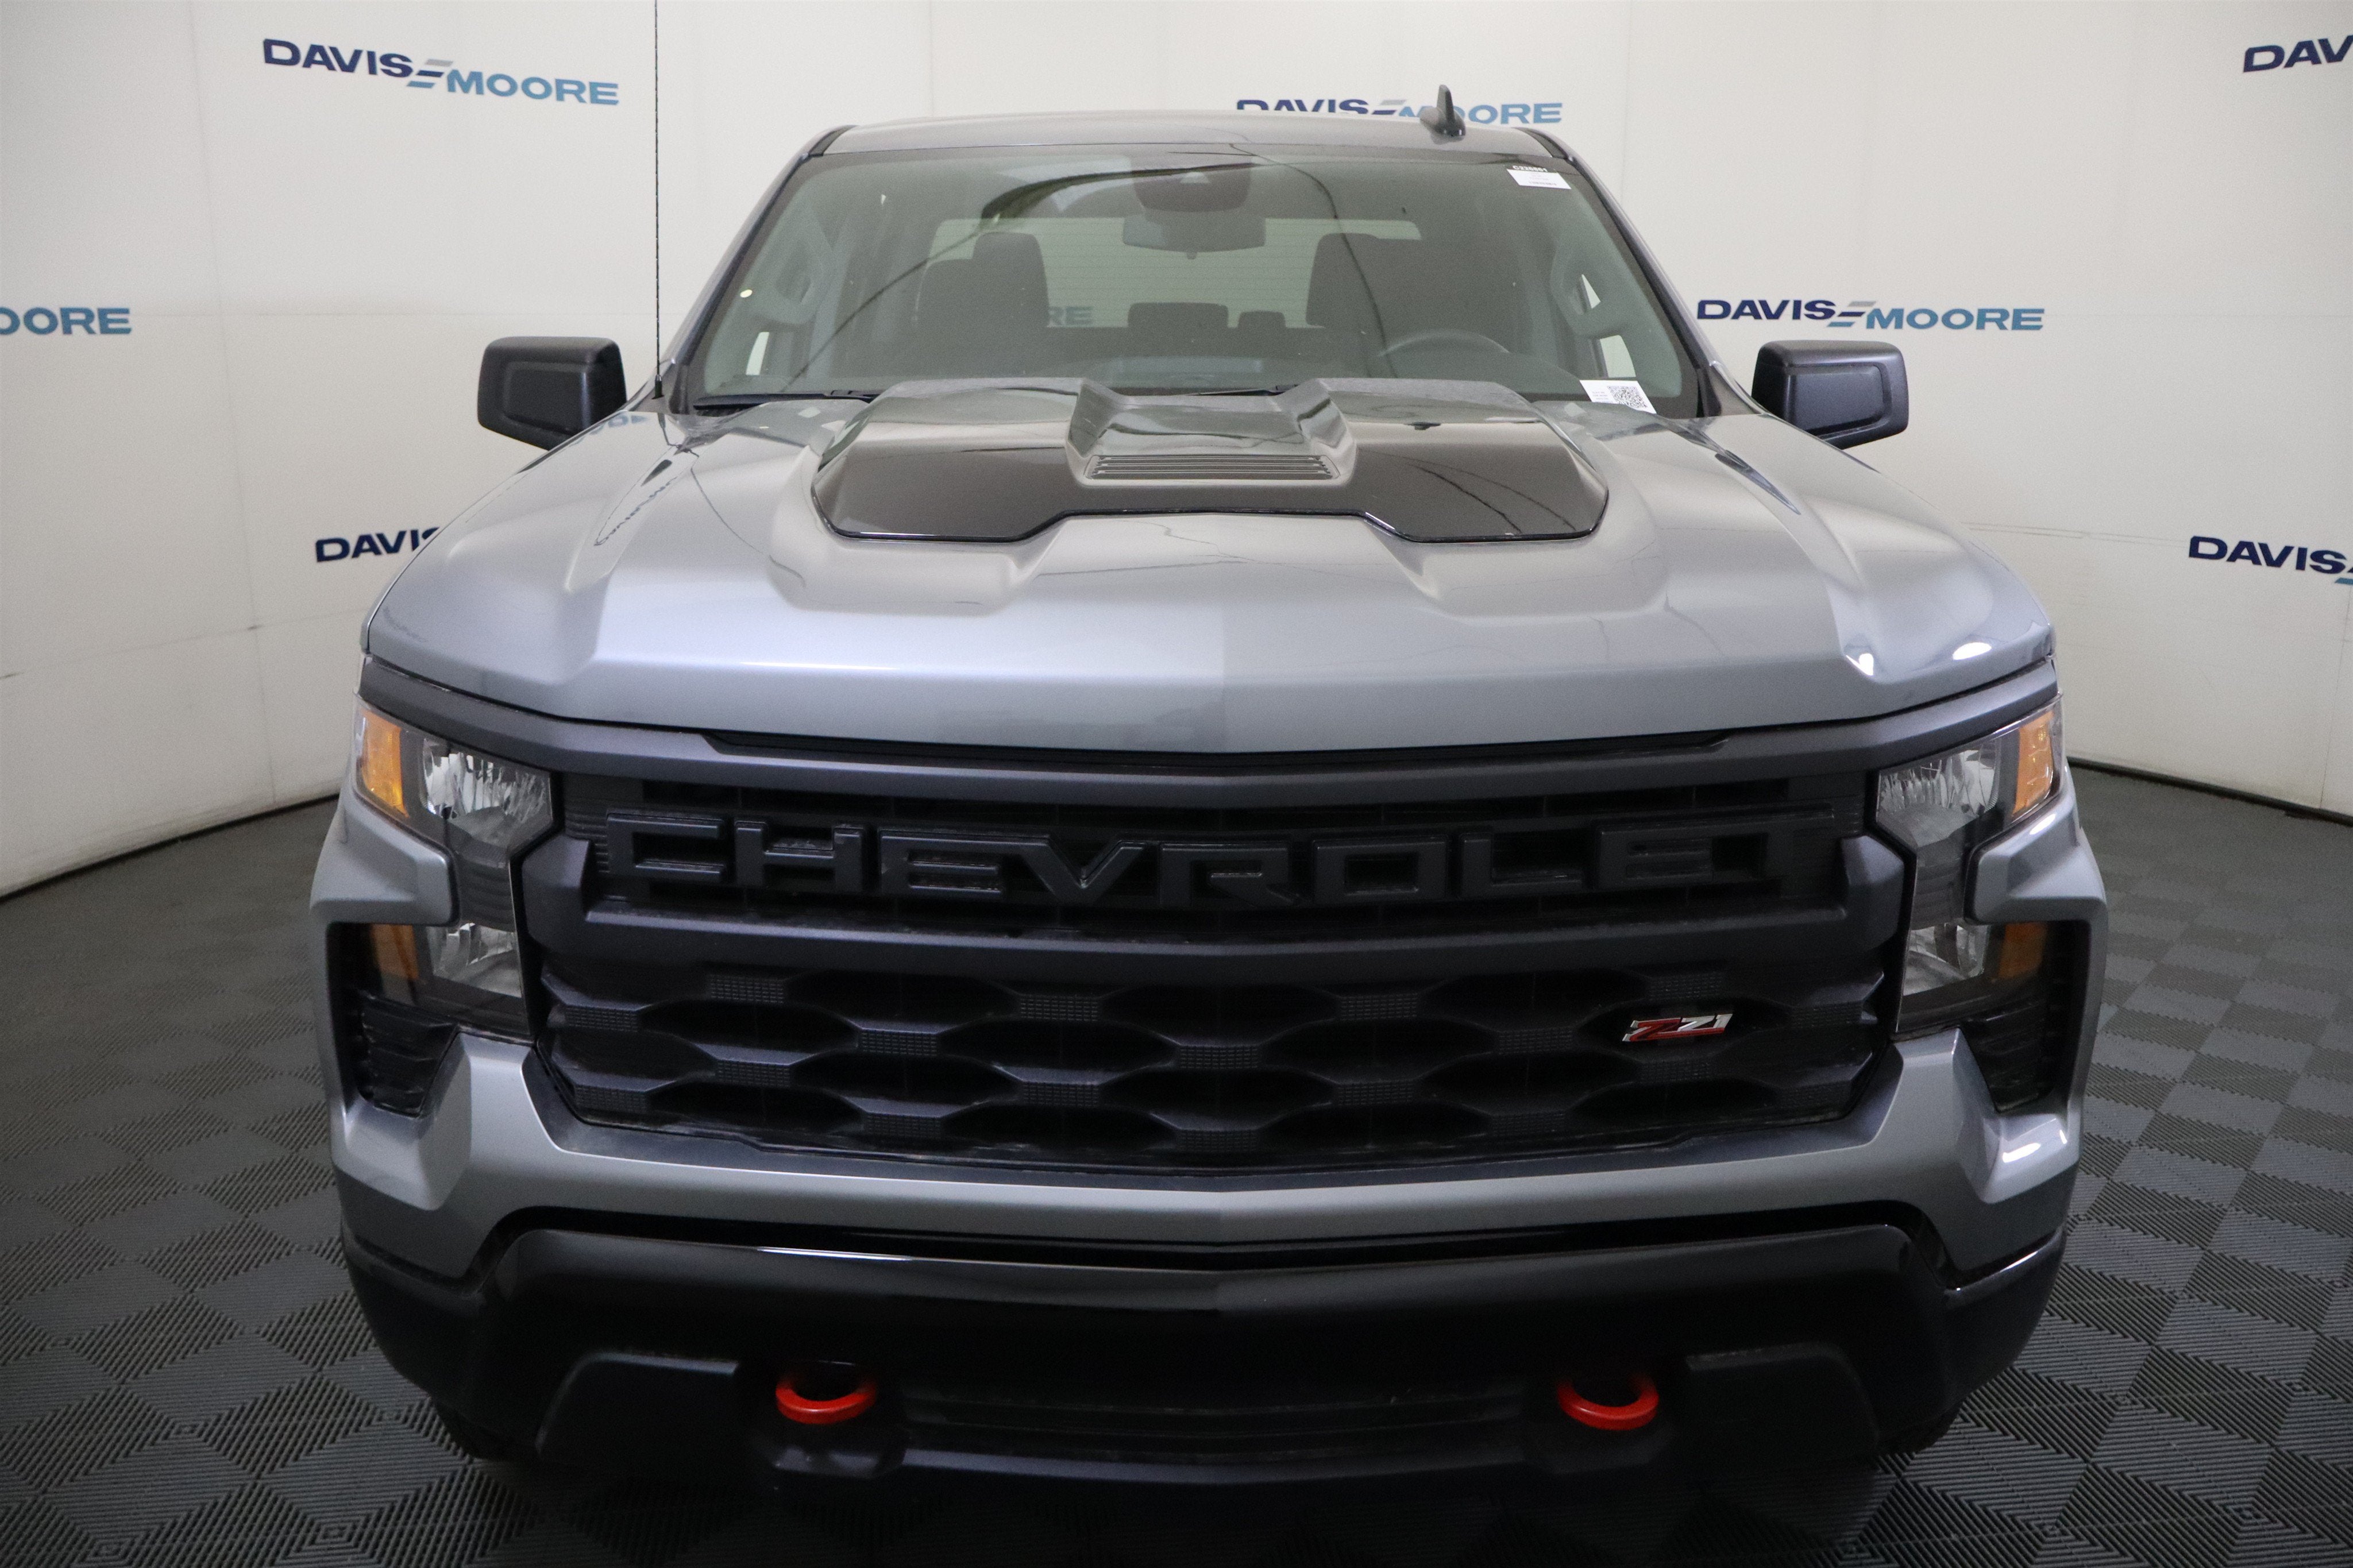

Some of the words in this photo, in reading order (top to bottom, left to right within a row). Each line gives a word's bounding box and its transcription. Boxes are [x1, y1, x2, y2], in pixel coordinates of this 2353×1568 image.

[263, 38, 413, 78] DAVIS
[447, 69, 619, 105] MOORE
[1696, 299, 1838, 320] DAVIS
[1866, 308, 2045, 331] MOORE
[2189, 535, 2347, 574] DAVIS
[606, 809, 1835, 906] CHEVROLET
[1622, 1013, 1733, 1042] Z71
